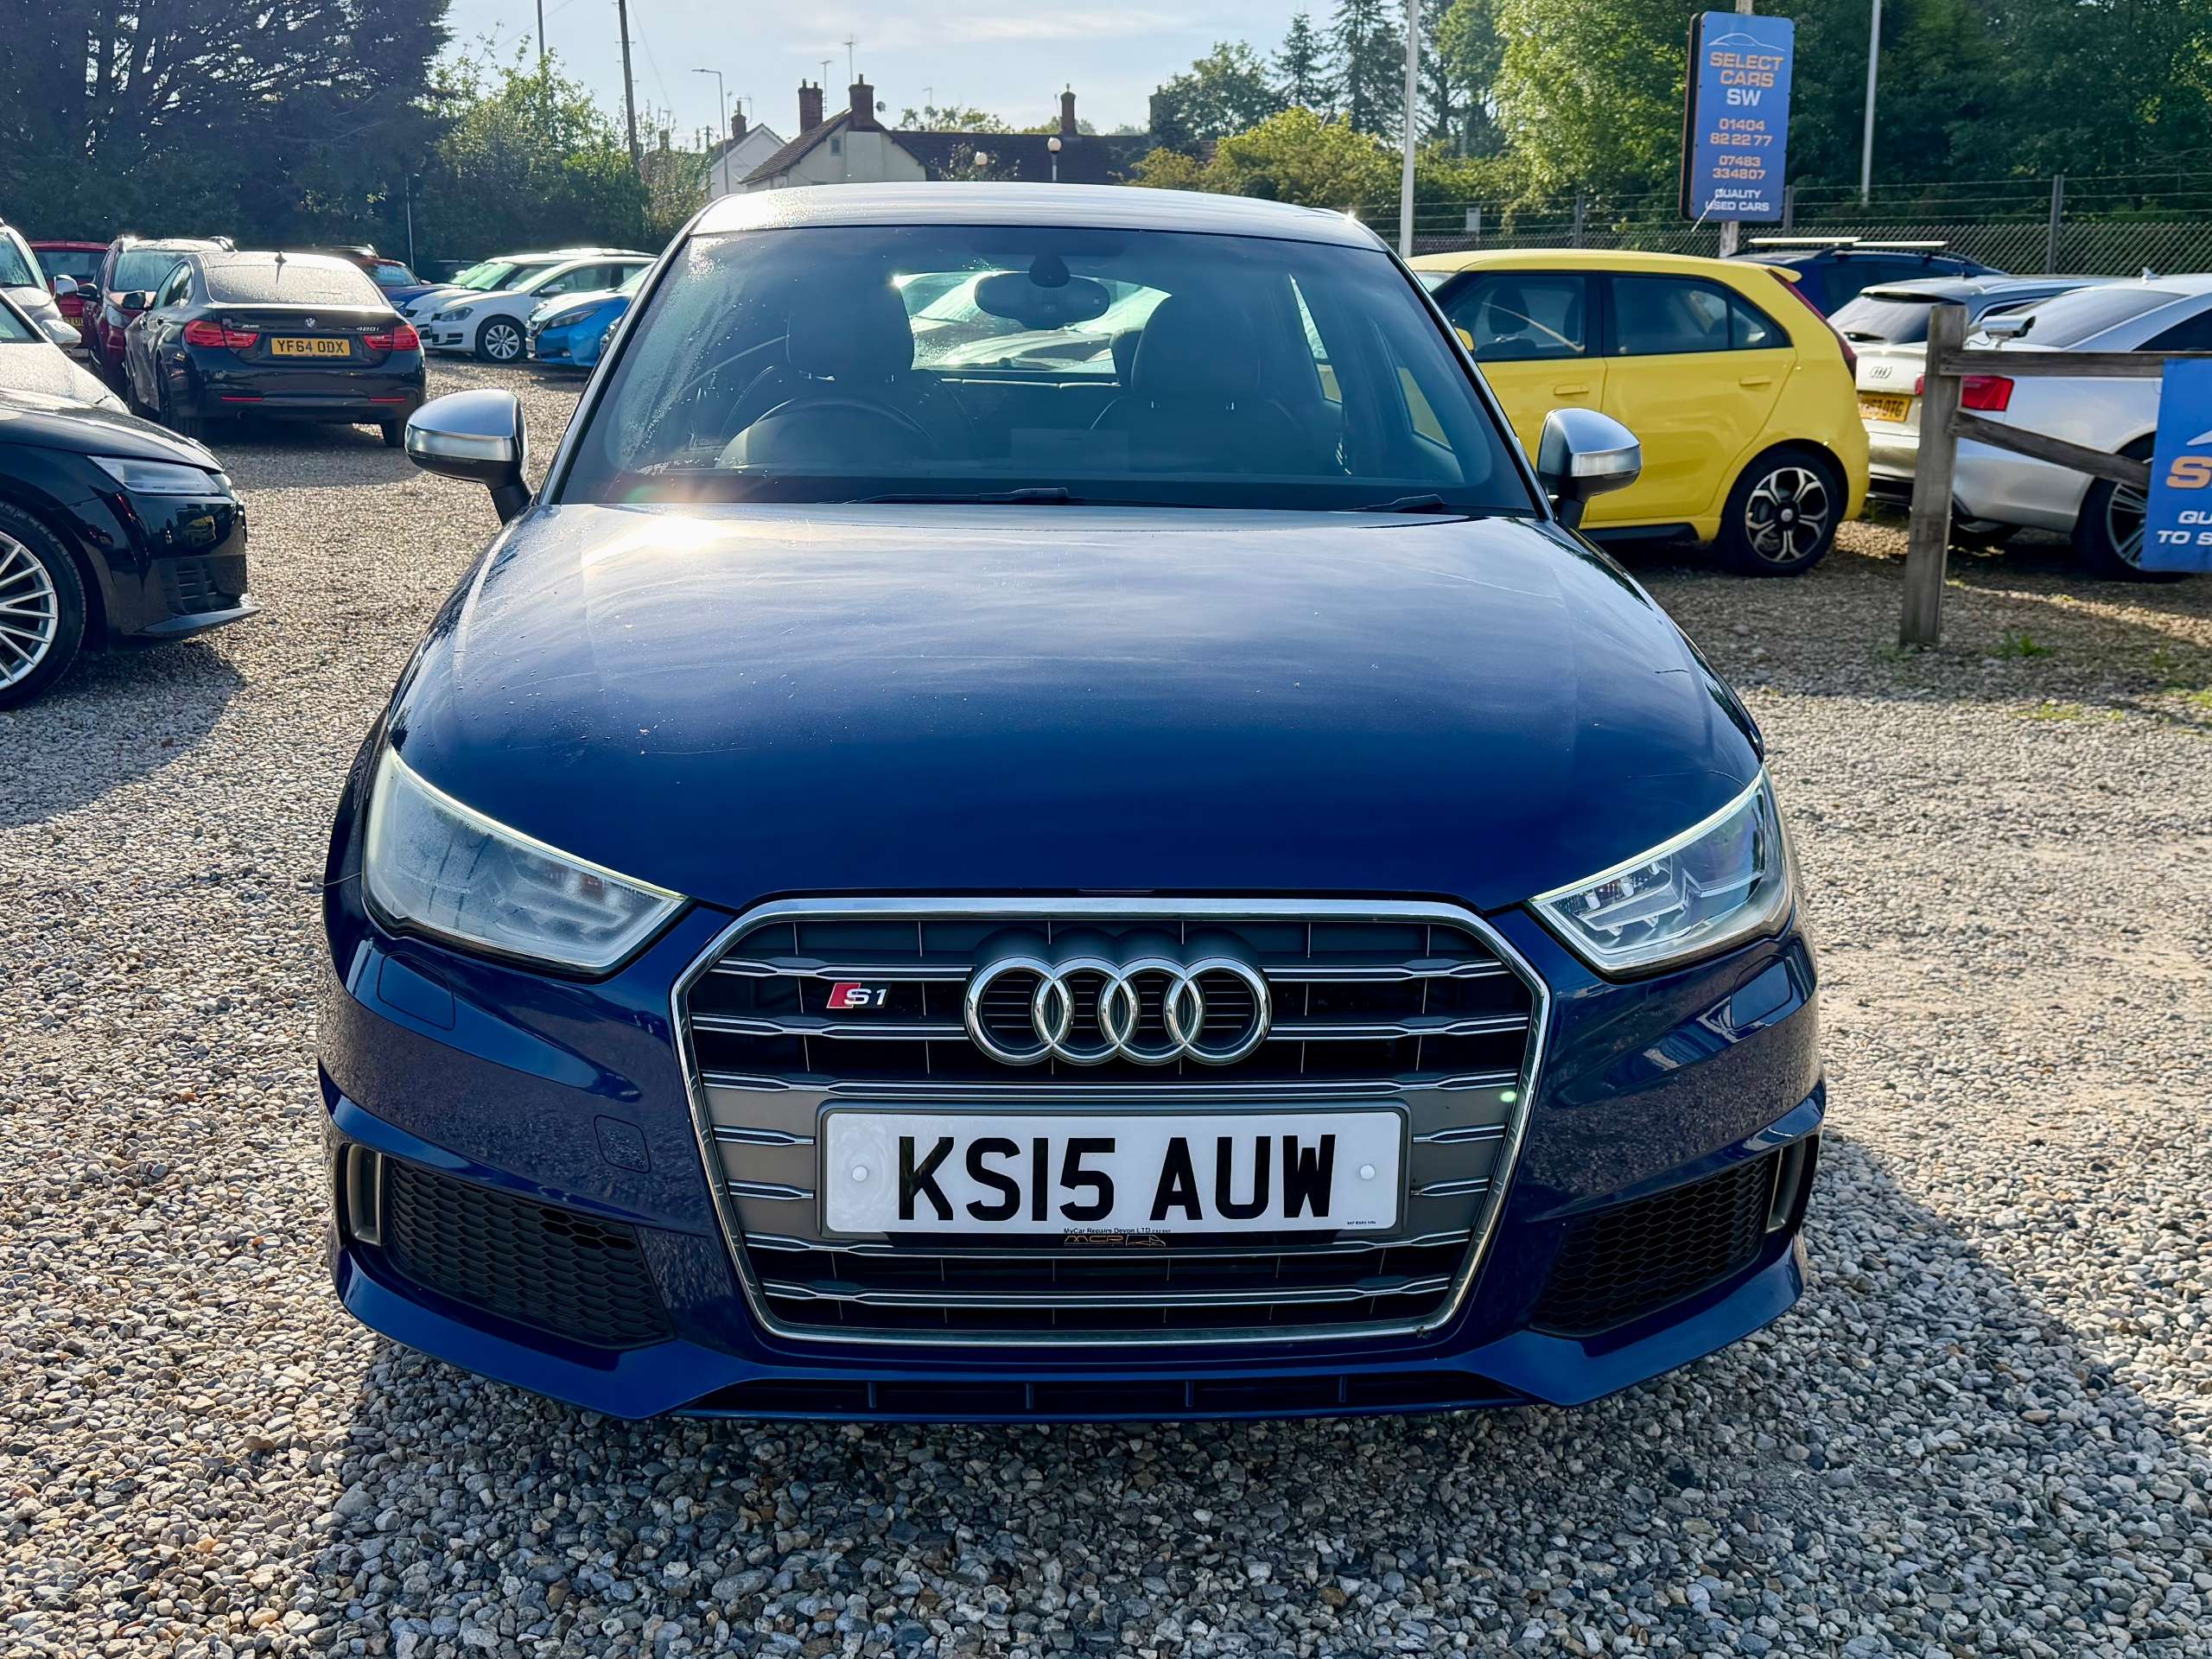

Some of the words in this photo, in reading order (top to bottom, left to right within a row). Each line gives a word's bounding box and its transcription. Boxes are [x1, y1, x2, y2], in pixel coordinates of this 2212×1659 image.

[1710, 52, 1783, 71] SELECT
[1720, 70, 1774, 87] CARS
[1726, 88, 1761, 106] SW
[1719, 118, 1764, 131] 01404
[1719, 155, 1761, 167] 07483
[1713, 168, 1766, 180] 334807
[1714, 188, 1762, 199] QUALITY
[1705, 200, 1736, 211] USED
[1738, 200, 1770, 212] CARS
[277, 340, 313, 353] YF64
[317, 340, 344, 353] ODX
[2166, 456, 2212, 489] S
[2157, 530, 2190, 544] TO
[844, 988, 887, 1005] S1
[899, 1136, 1116, 1222] KS15
[1149, 1134, 1336, 1221] AUW
